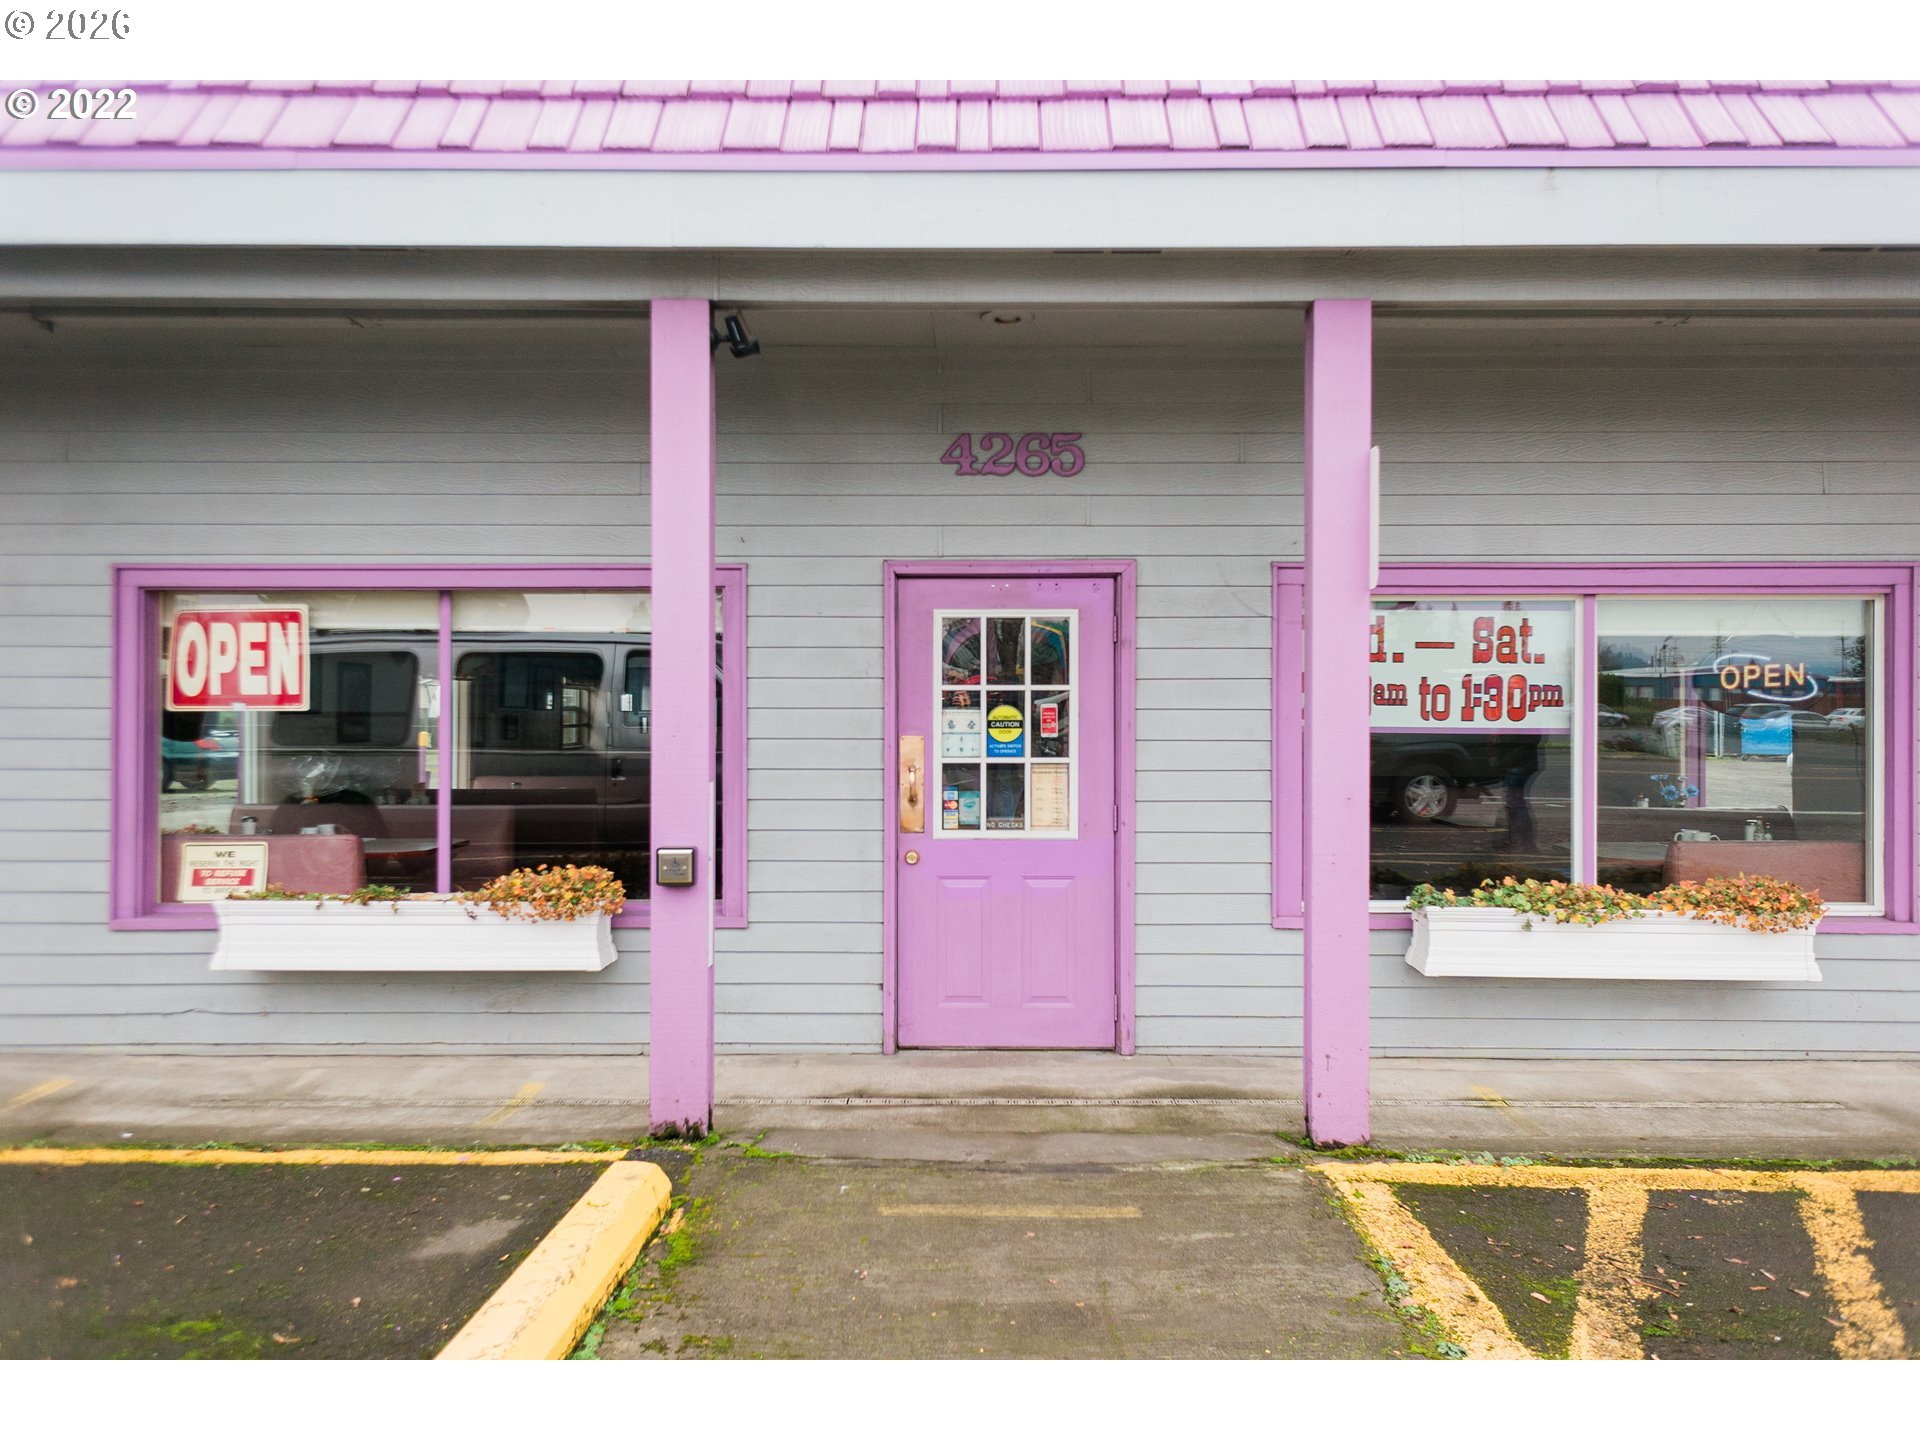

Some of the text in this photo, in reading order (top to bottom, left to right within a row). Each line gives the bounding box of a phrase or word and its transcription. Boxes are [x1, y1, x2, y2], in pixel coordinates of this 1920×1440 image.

[940, 432, 1085, 477] 4265
[1472, 616, 1545, 664] Sat.
[177, 621, 300, 697] OPEN
[1720, 662, 1805, 690] OPEN
[1419, 677, 1451, 721] to
[215, 850, 236, 858] WE
[200, 869, 248, 877] TO REFUSE
[205, 877, 242, 886] SERVICE
